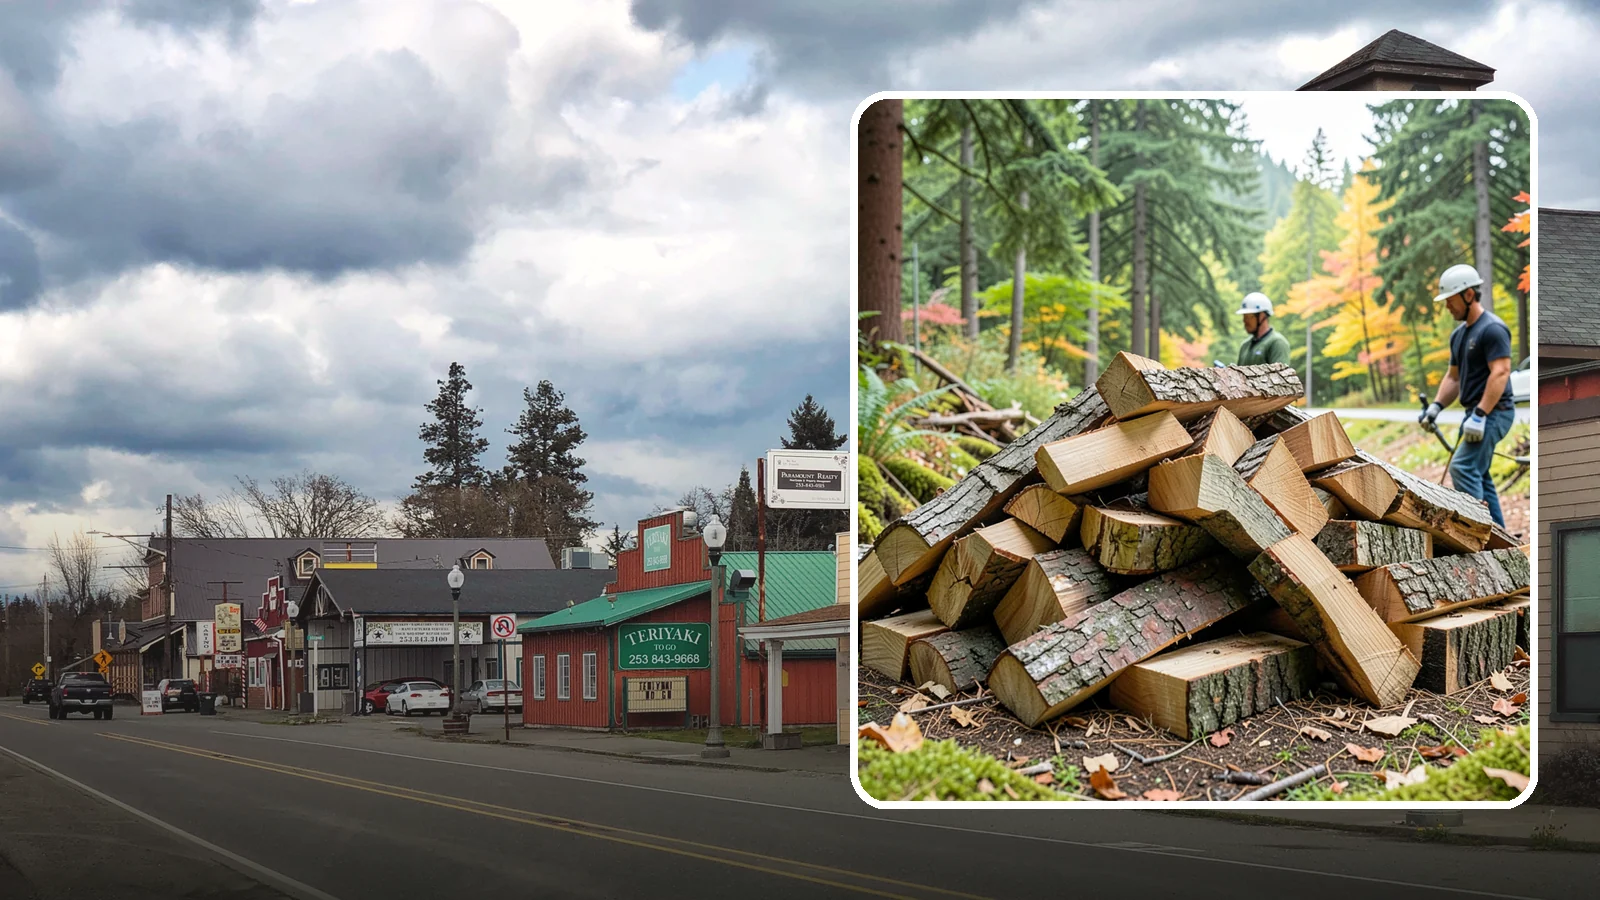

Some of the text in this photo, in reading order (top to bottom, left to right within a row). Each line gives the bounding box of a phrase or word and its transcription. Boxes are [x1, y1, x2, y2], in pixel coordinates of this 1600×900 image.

[781, 471, 839, 480] PARAMOUNT REALTY
[625, 627, 702, 646] TERIYAKI
[628, 653, 700, 664] 253 843-9668
